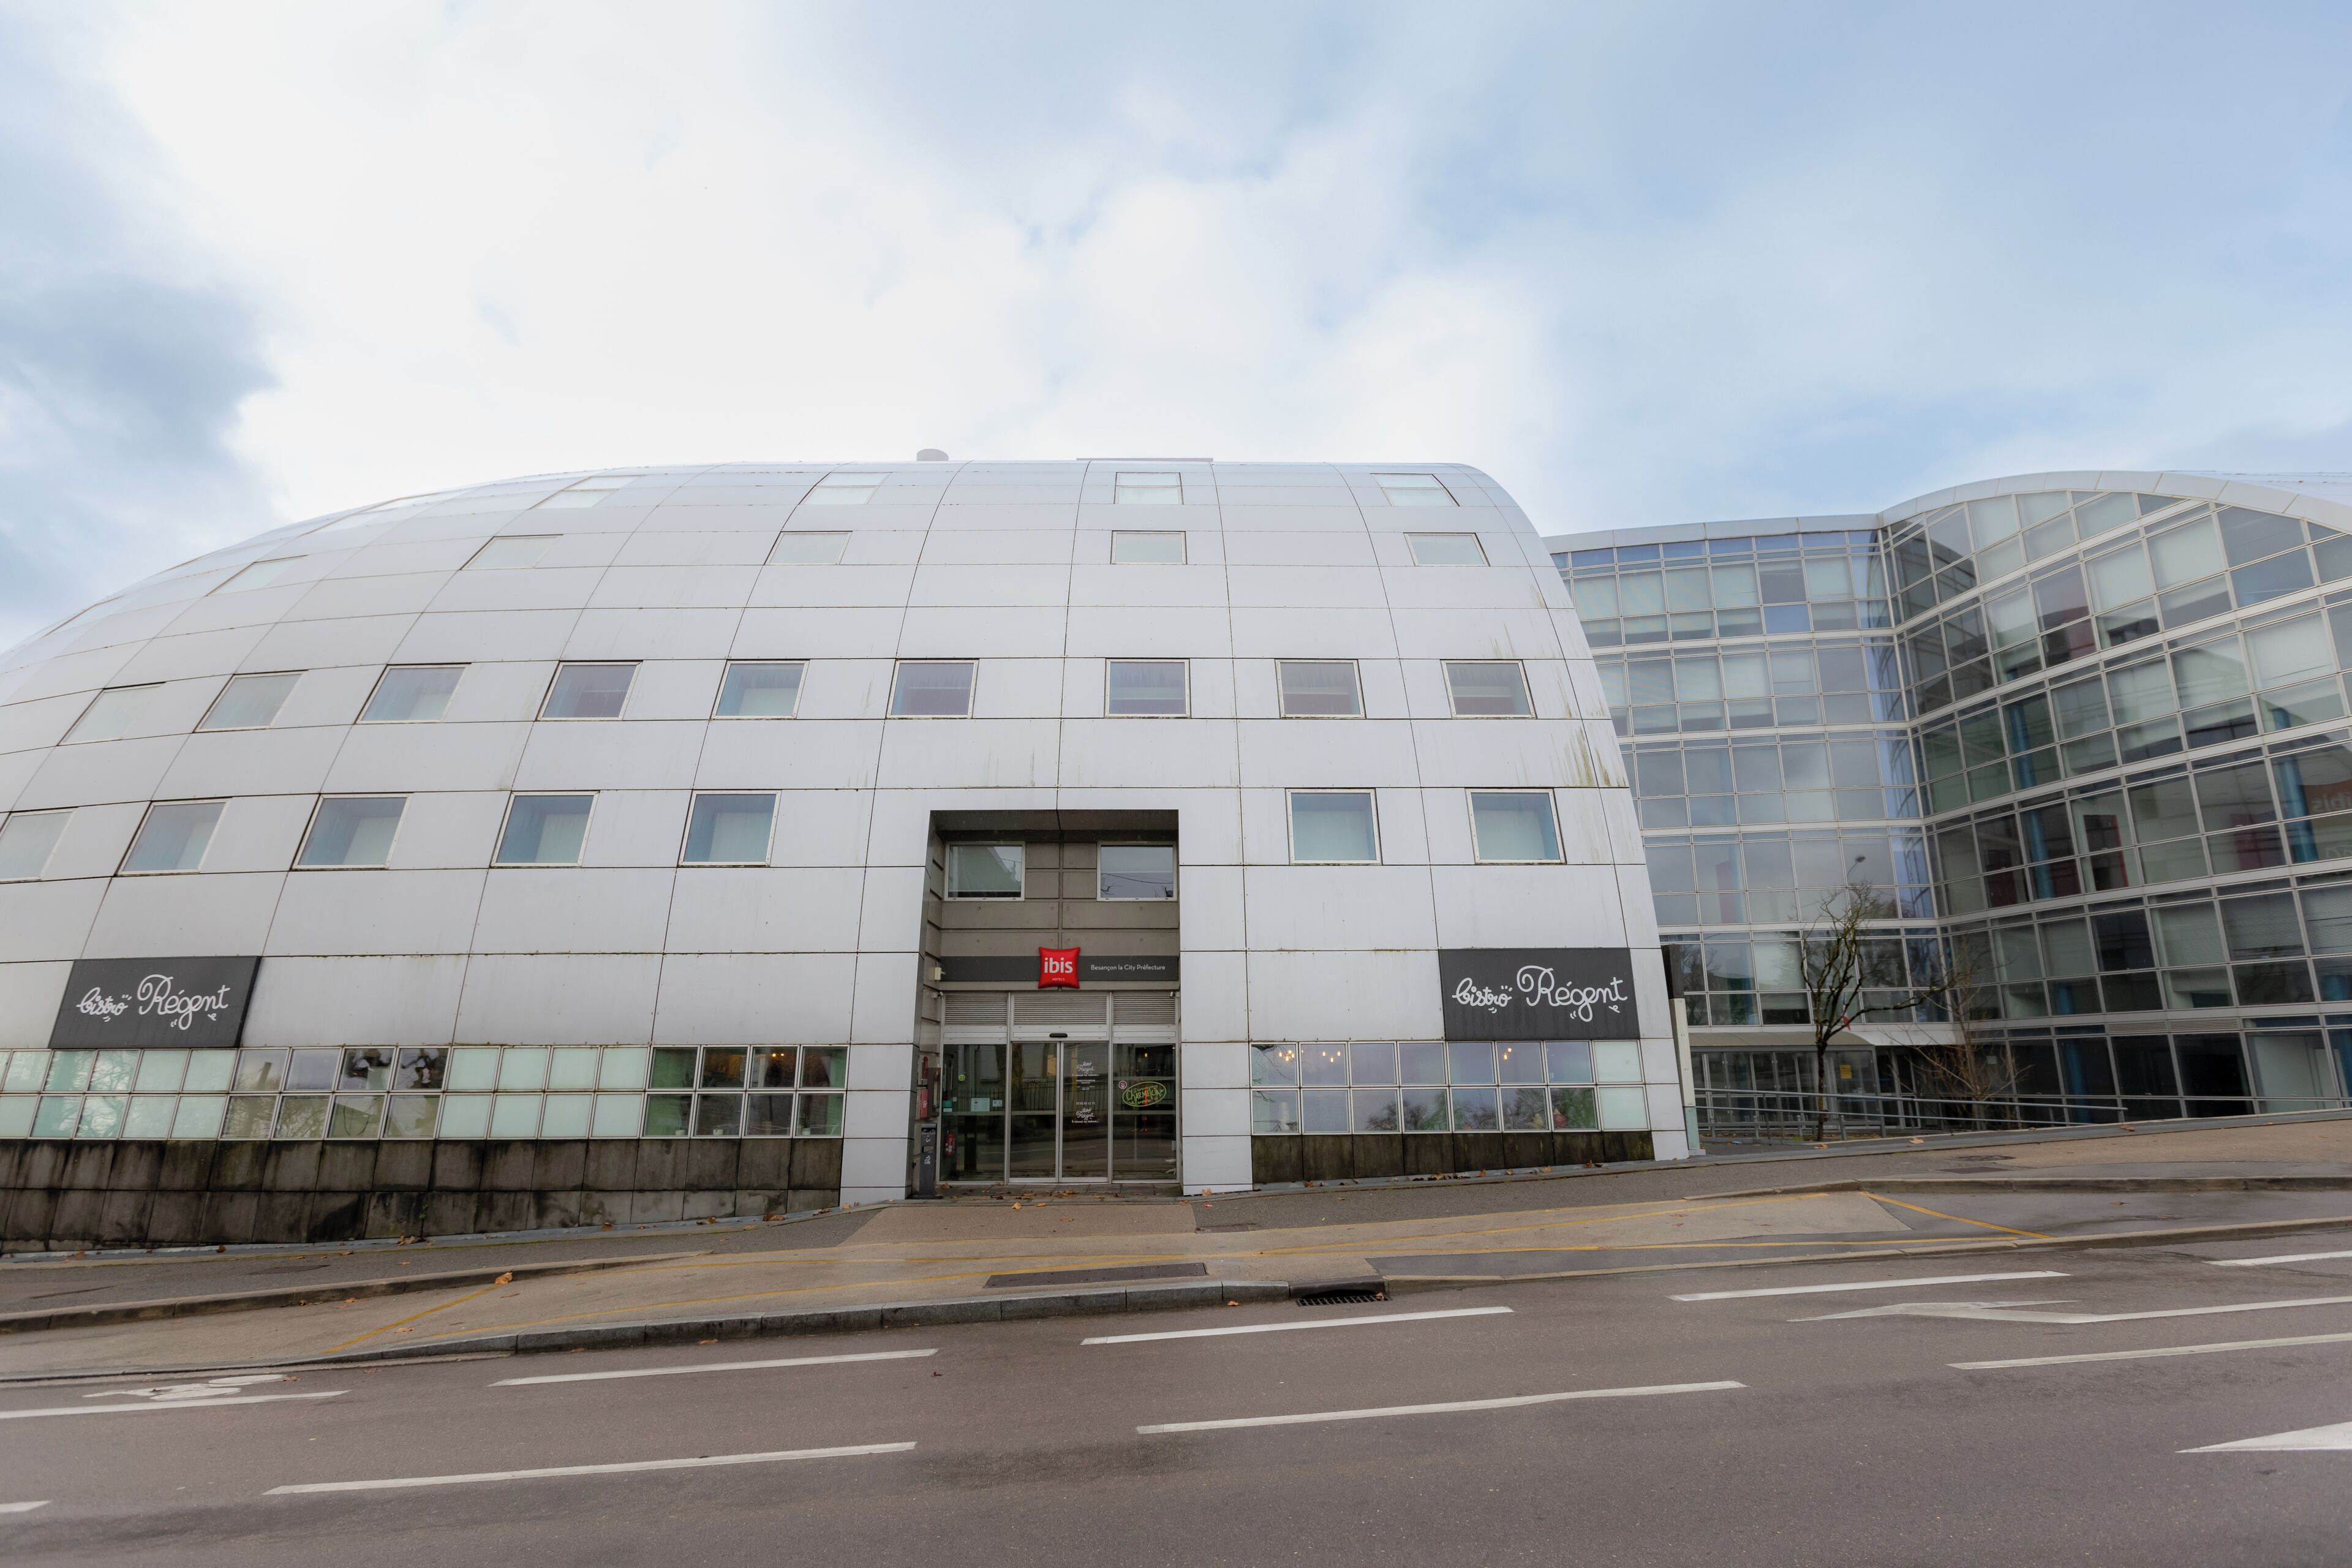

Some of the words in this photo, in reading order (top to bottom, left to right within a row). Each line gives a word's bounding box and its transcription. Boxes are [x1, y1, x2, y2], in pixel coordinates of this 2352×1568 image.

[1044, 957, 1073, 973] ibis
[76, 987, 130, 1016] bistro
[137, 974, 230, 1030] Régent
[1452, 977, 1513, 1008] bistro
[1516, 965, 1628, 1022] Régent
